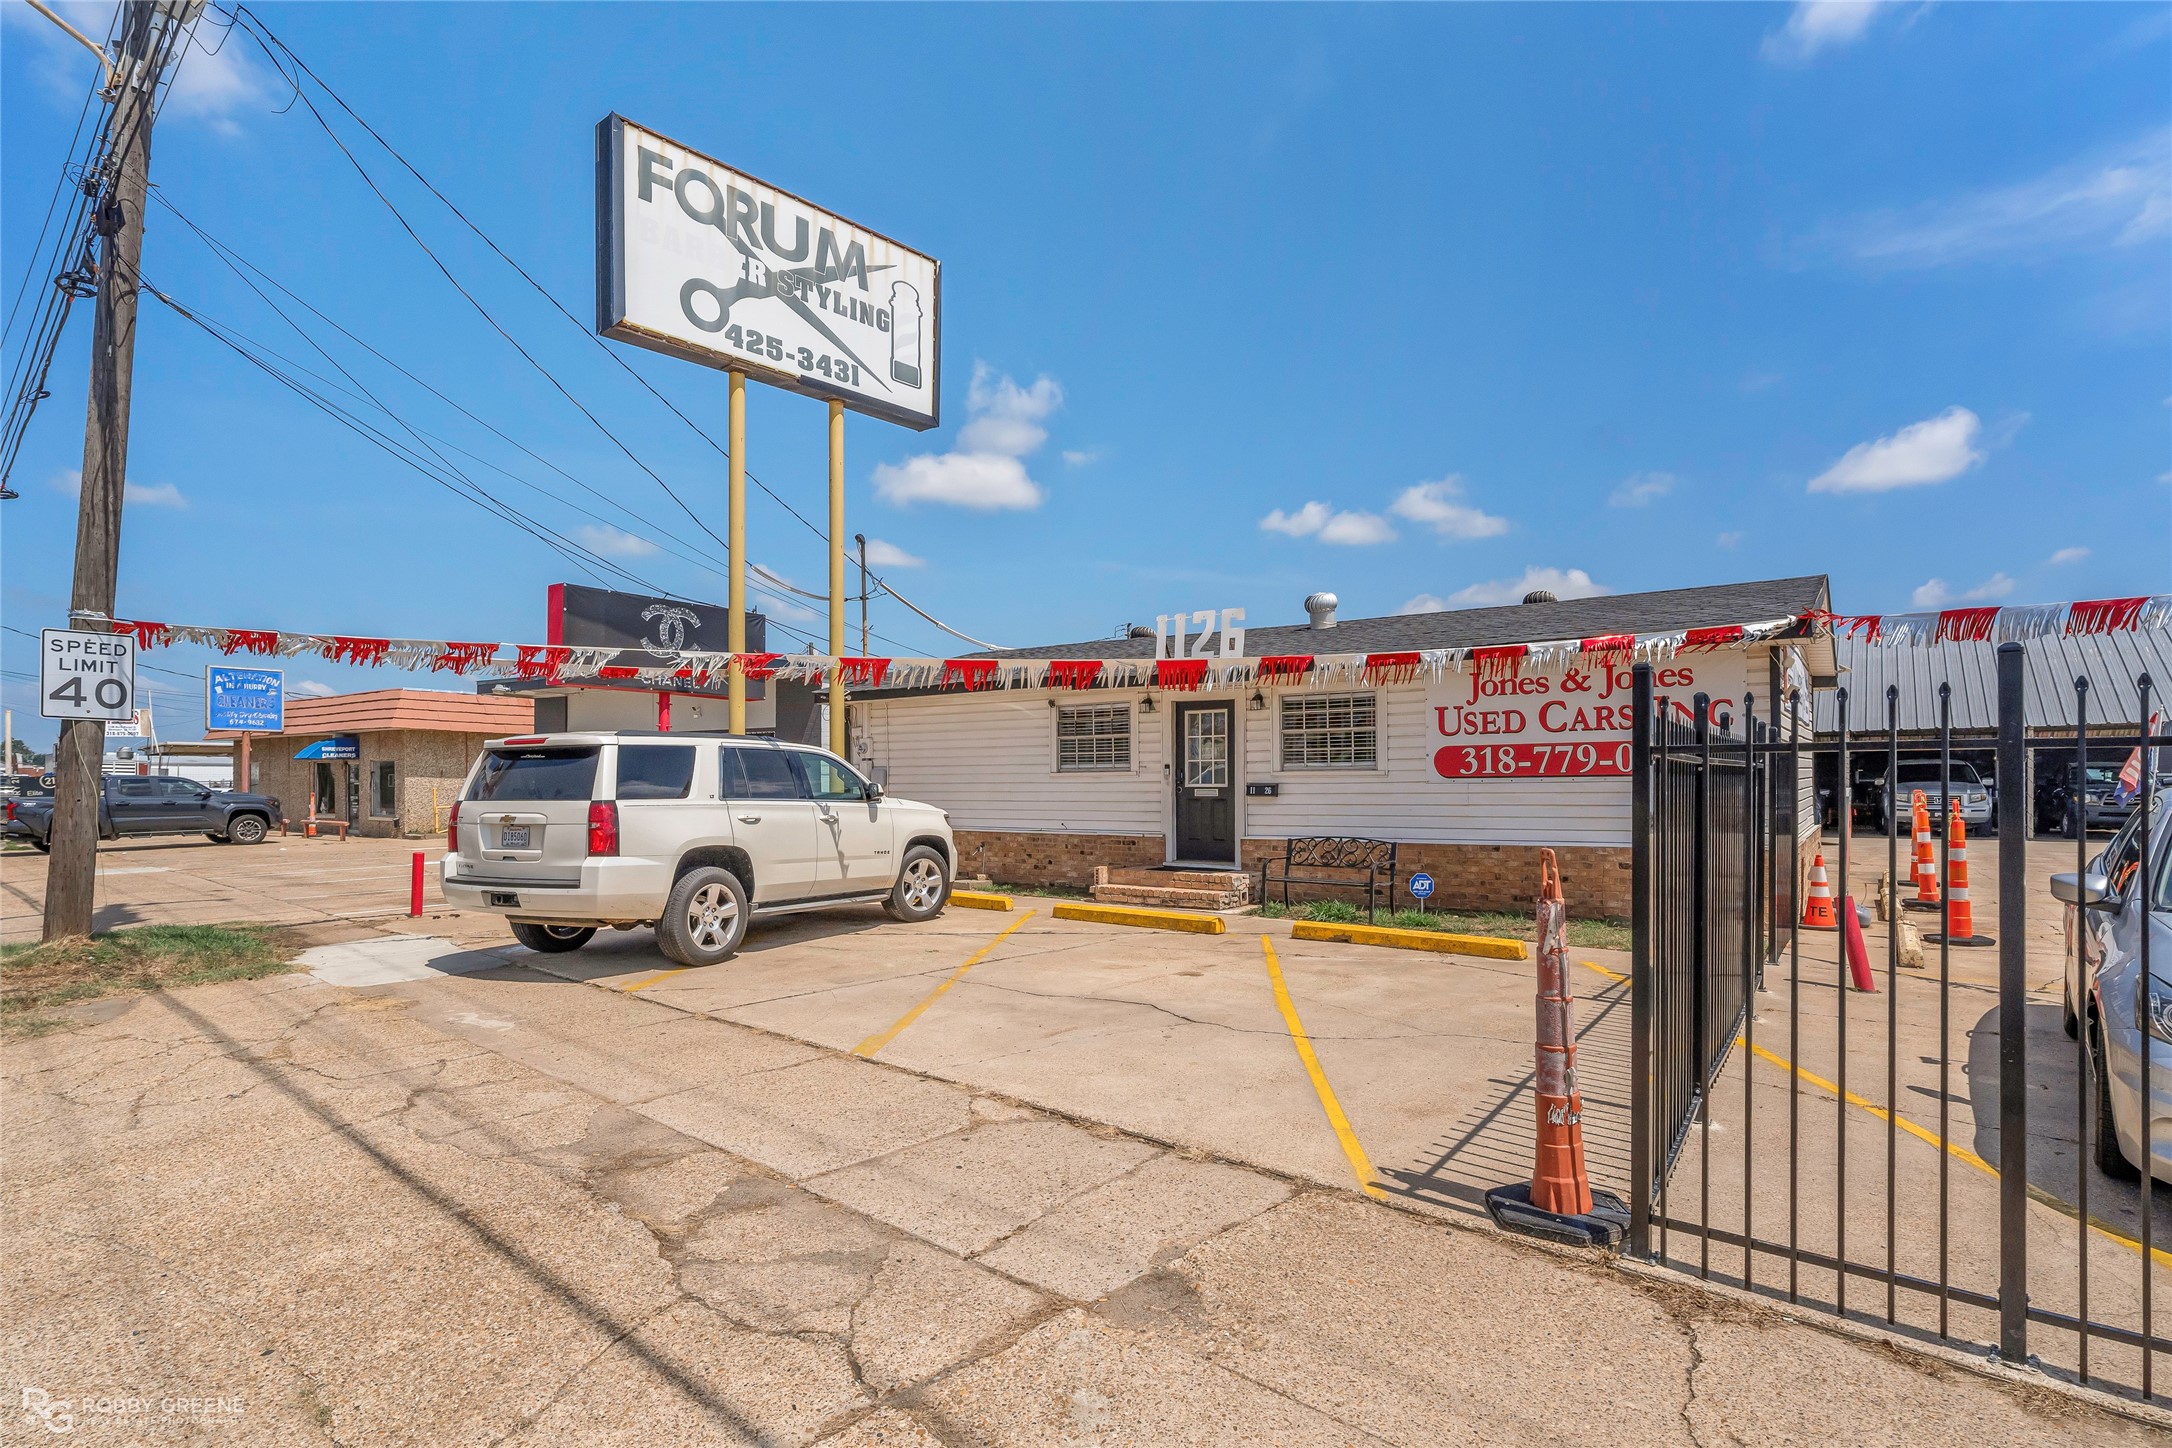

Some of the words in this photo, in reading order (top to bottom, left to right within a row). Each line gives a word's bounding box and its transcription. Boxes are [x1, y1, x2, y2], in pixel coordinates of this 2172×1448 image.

[637, 144, 869, 292] FORUM
[776, 269, 890, 333] STYLING
[724, 323, 860, 387] 425-3431
[50, 638, 127, 657] SPEED
[1155, 607, 1246, 660] 1126
[58, 657, 119, 674] LIMIT
[49, 676, 128, 710] 40
[243, 683, 267, 691] HURRY
[1466, 671, 1550, 706] Jones
[1559, 666, 1592, 693] &
[1598, 664, 1694, 700] Joes
[216, 694, 275, 709] CLEANERS
[1434, 705, 1527, 737] USED
[1412, 880, 1432, 890] ADT
[1810, 905, 1828, 918] TE
